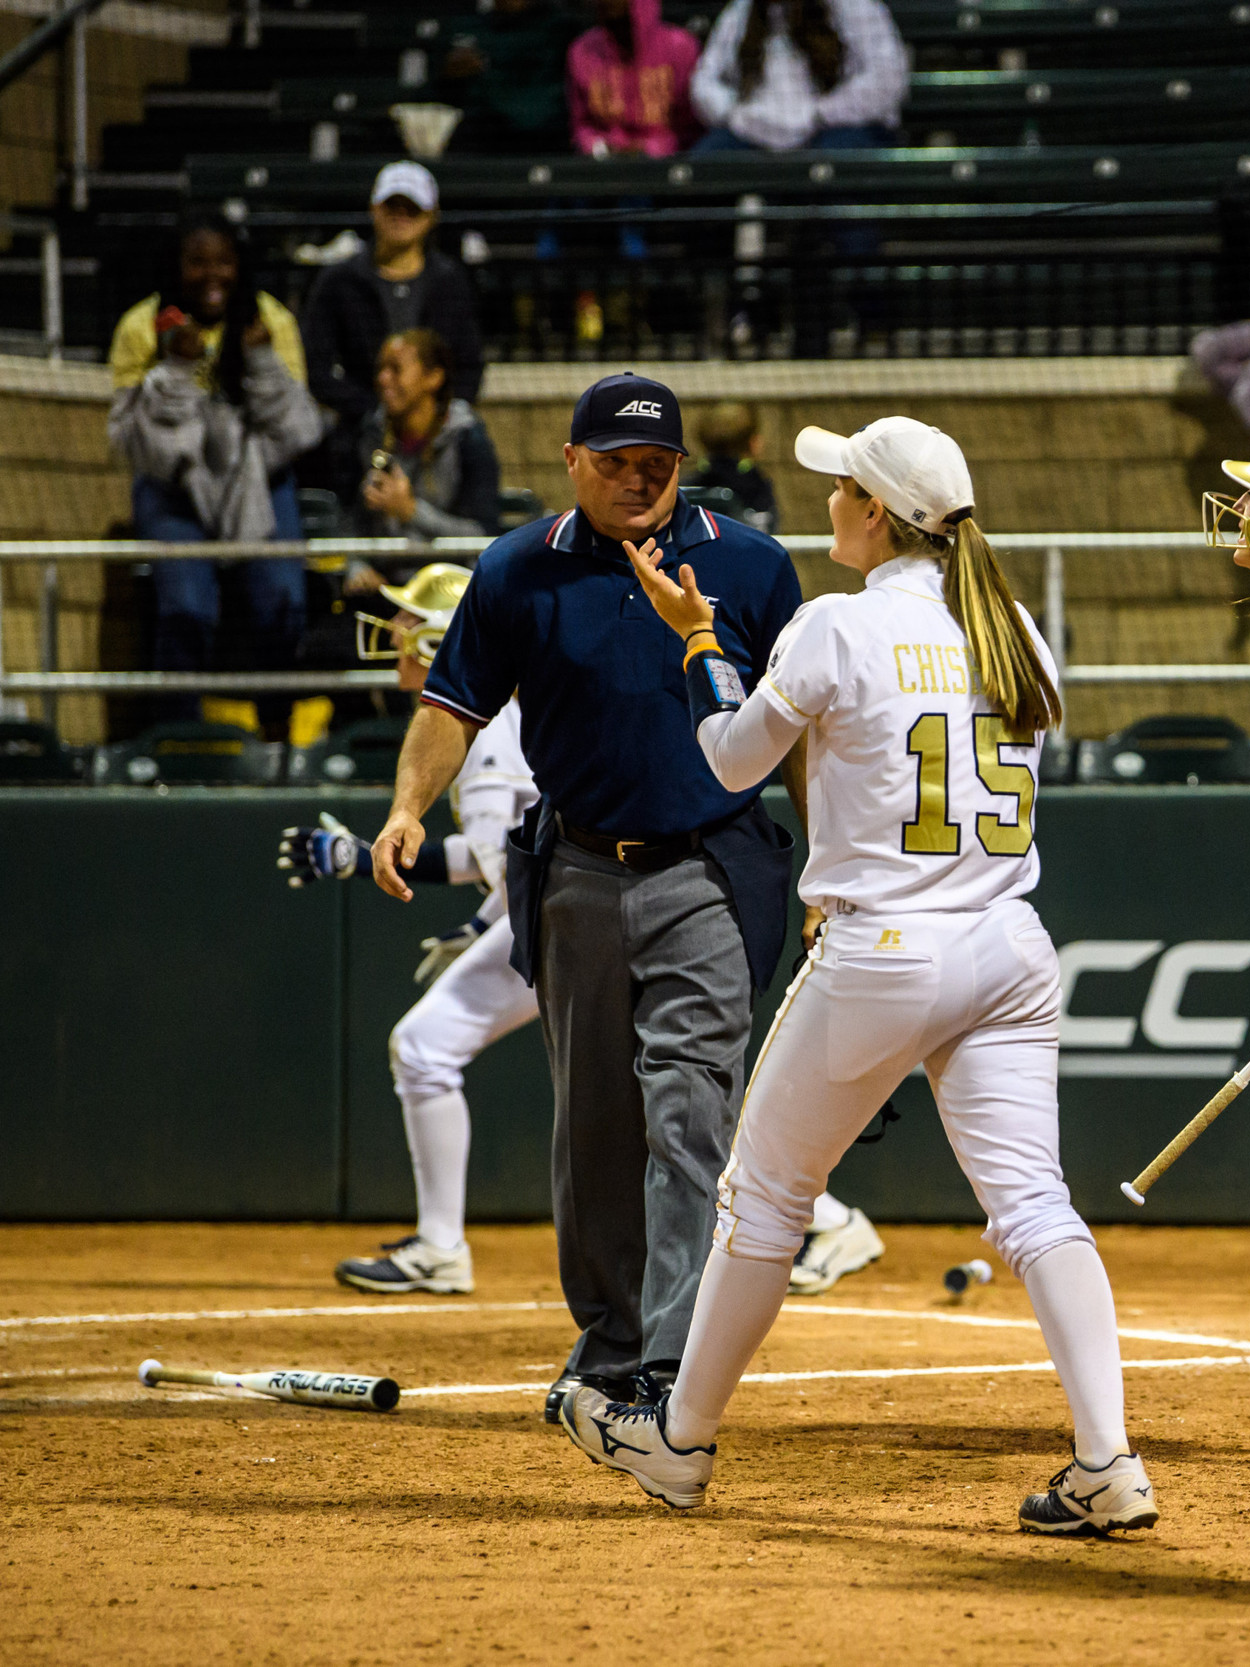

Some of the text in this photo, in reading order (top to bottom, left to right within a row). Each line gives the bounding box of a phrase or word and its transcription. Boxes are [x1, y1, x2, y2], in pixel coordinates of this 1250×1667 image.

[617, 400, 662, 418] ACC
[901, 712, 1035, 857] 15
[269, 1372, 375, 1395] RAWLINGS
